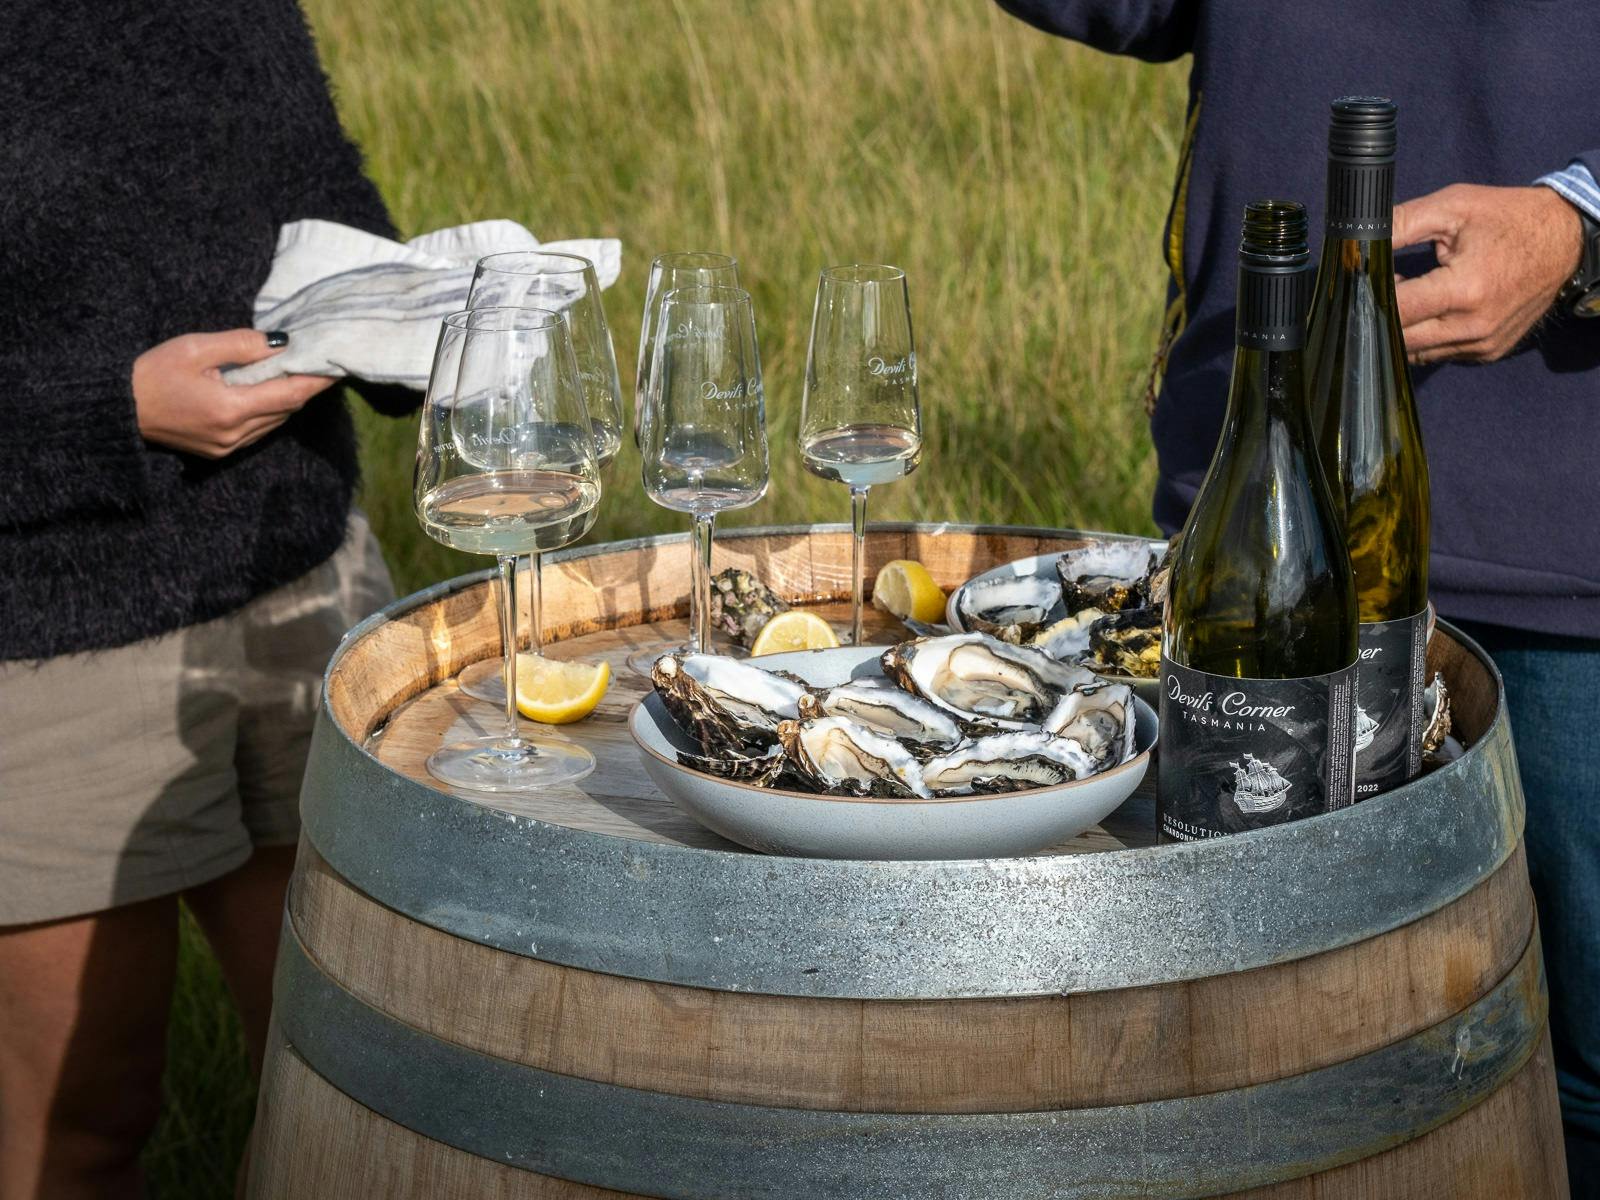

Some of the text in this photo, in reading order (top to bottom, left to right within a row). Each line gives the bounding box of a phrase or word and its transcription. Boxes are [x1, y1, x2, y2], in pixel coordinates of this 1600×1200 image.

[1167, 674, 1296, 718] Devil's Corner
[1182, 710, 1266, 732] TASMANIA
[1357, 783, 1379, 793] 2022
[1163, 813, 1230, 838] RESOLUTIO
